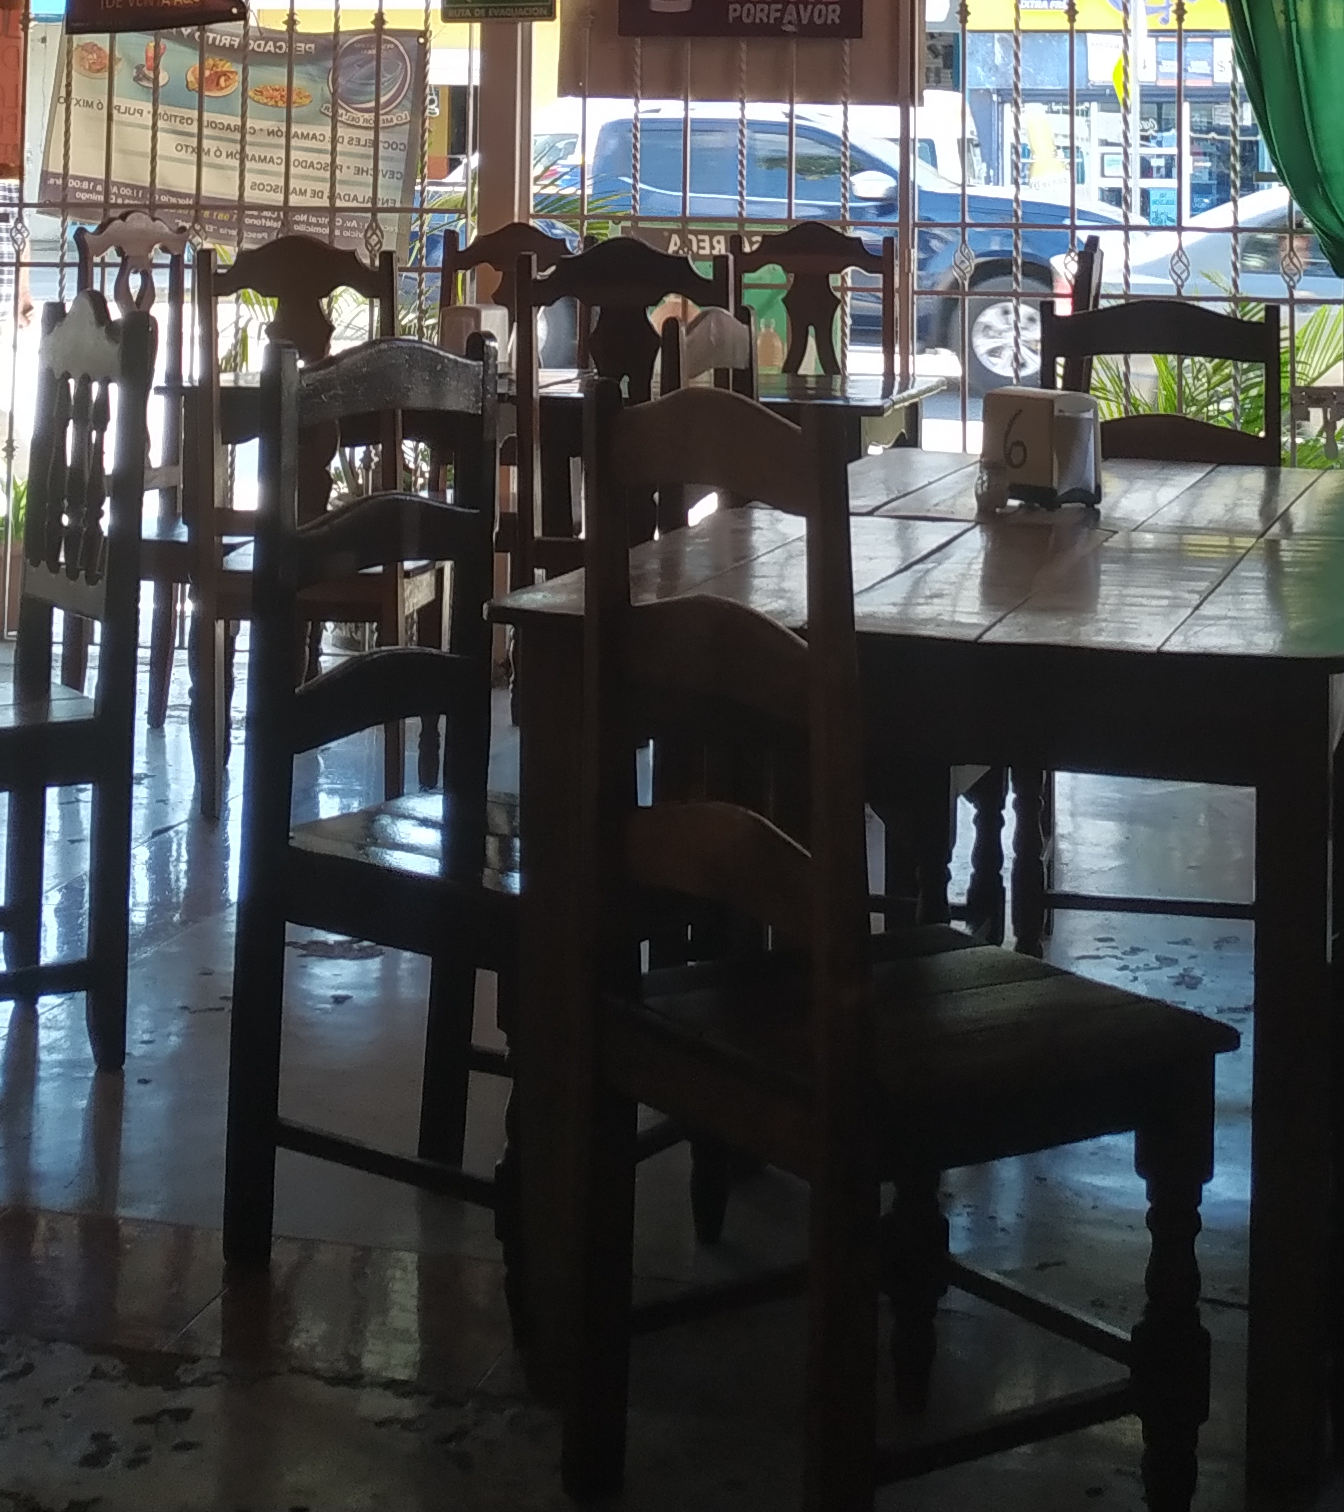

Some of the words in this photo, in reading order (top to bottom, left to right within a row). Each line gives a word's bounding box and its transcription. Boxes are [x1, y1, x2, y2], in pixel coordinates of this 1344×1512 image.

[448, 8, 471, 17] RUTA
[474, 8, 485, 16] DE
[728, 3, 840, 25] PORFAVOR
[1003, 409, 1027, 469] 6
